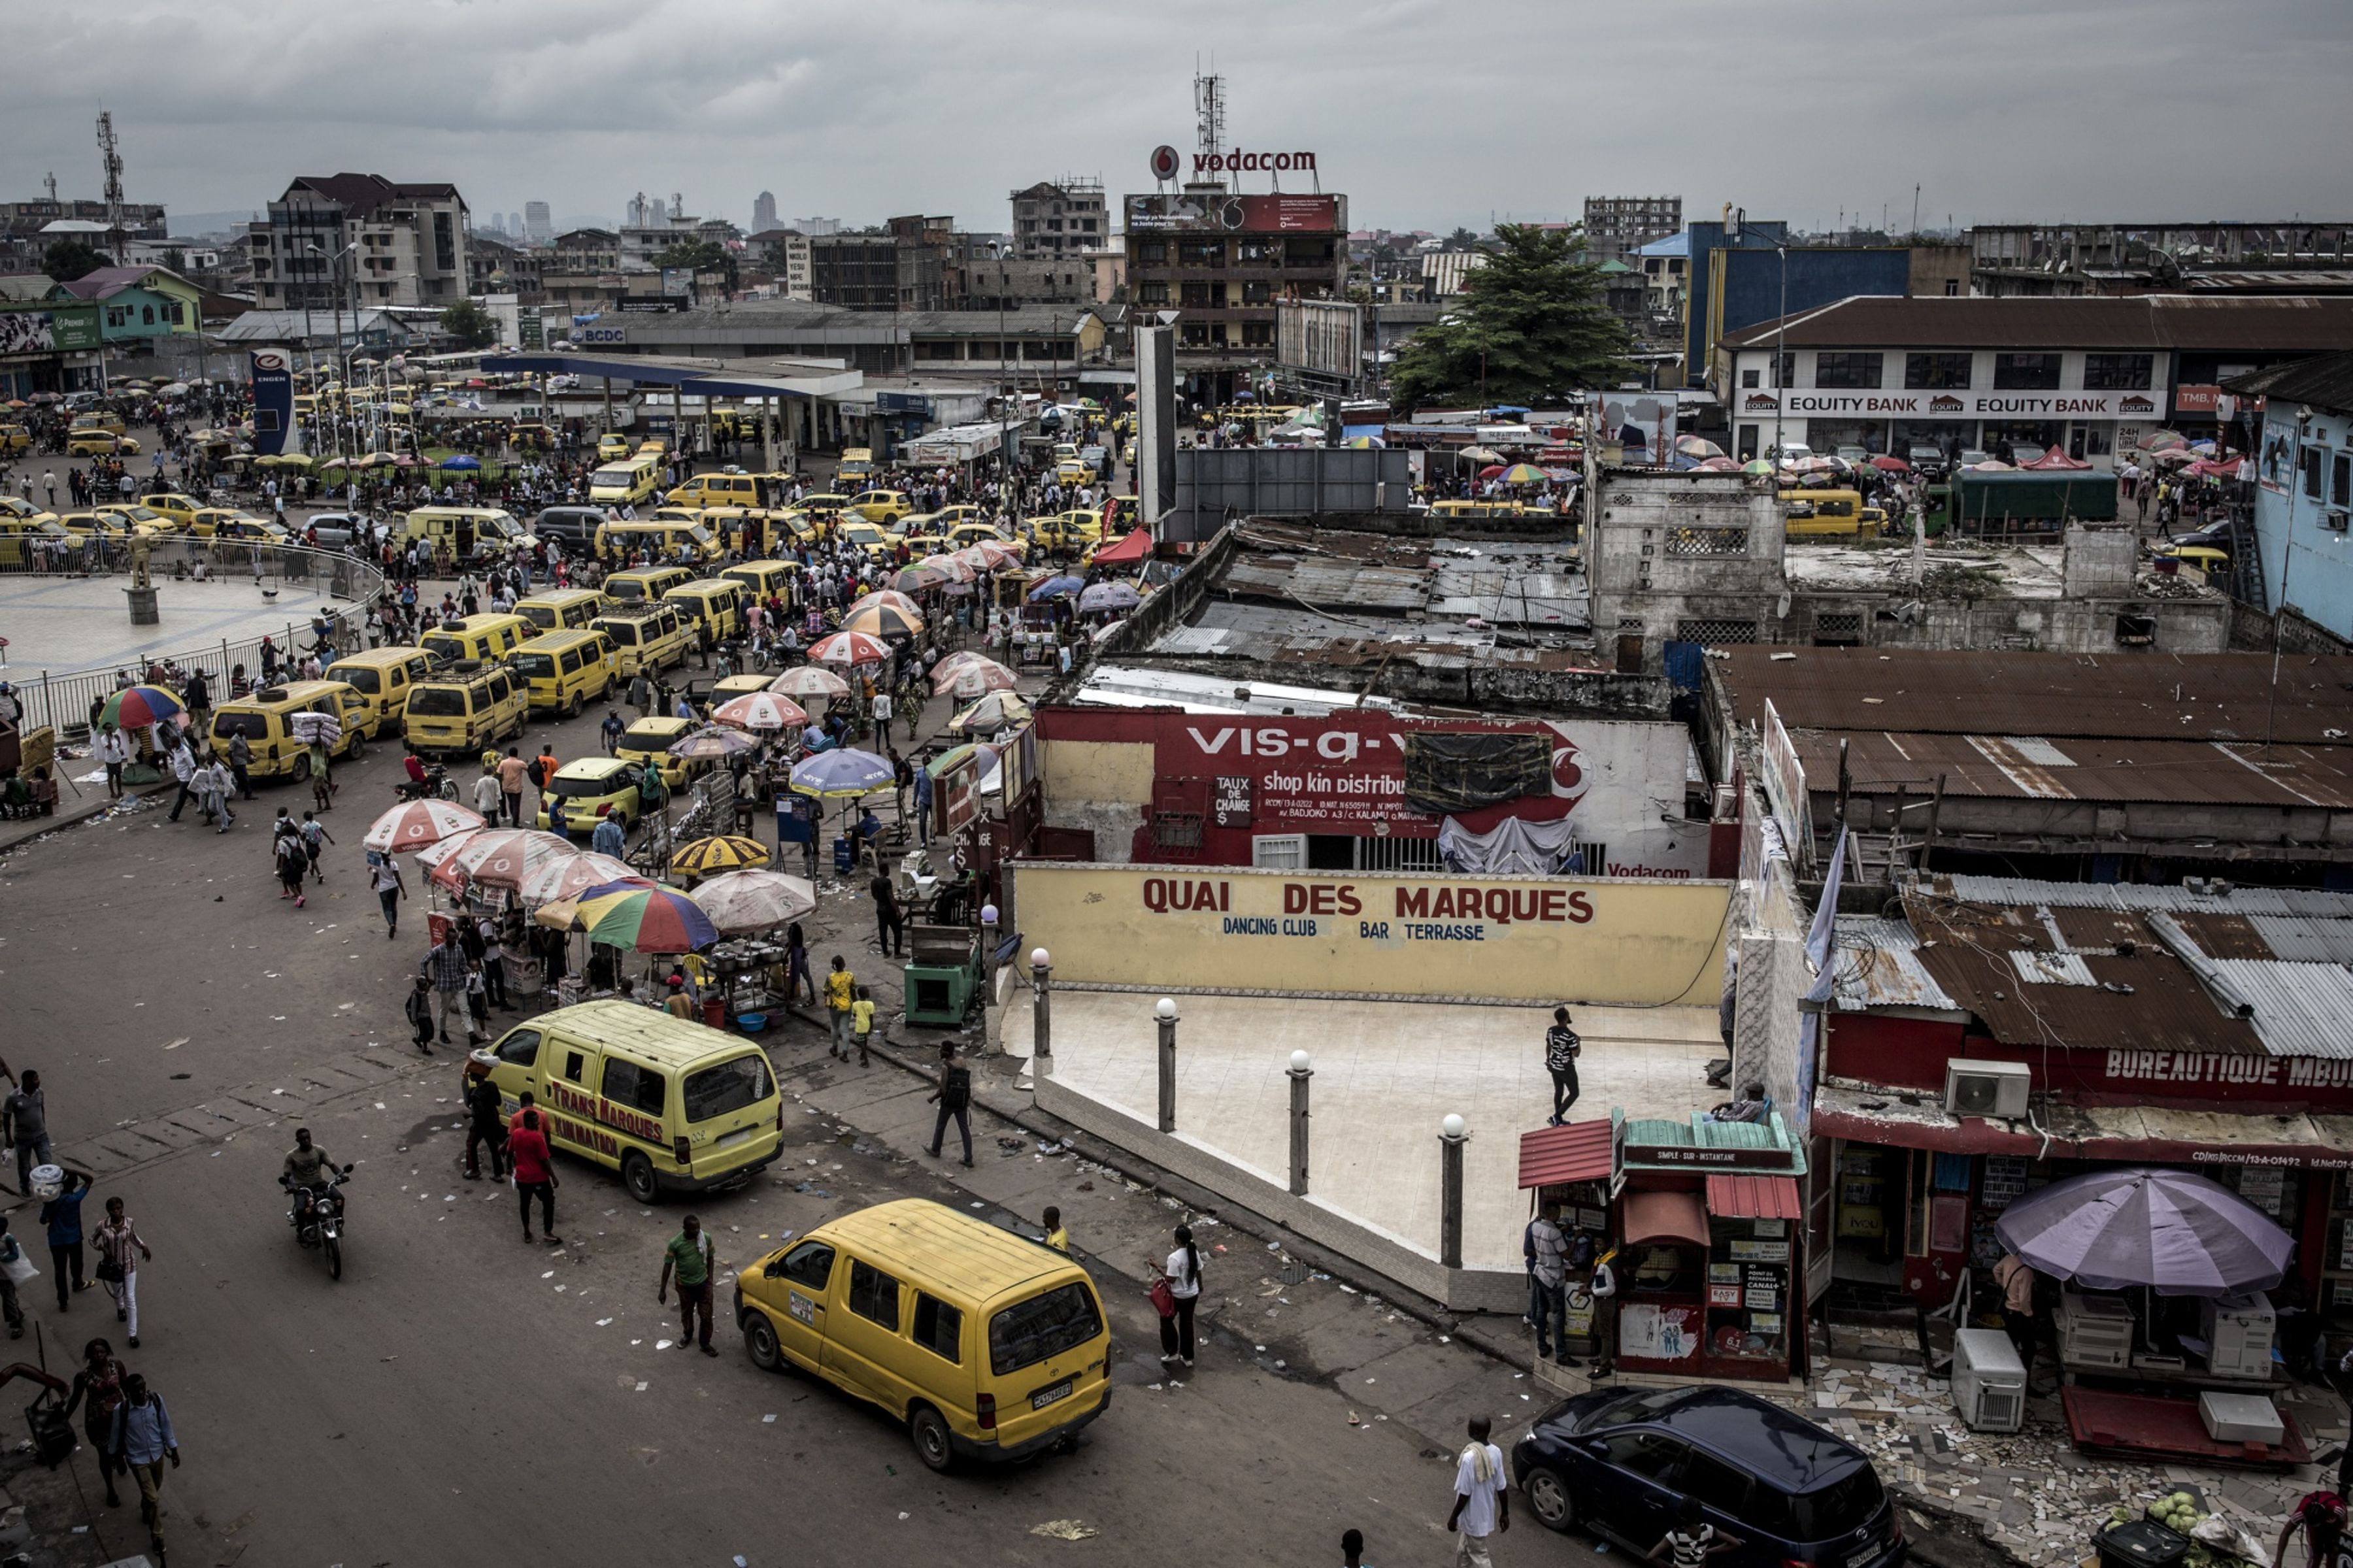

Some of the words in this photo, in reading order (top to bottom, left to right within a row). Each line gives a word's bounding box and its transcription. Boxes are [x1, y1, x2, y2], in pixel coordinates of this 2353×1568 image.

[1193, 148, 1315, 171] vodacom
[585, 330, 624, 341] BCDC
[1790, 397, 1863, 410] EQUITY
[1867, 398, 1918, 411] BANK
[1977, 399, 2052, 412] EQUITY
[2055, 399, 2107, 412] BANK
[542, 761, 548, 772] 3
[1216, 776, 1249, 790] TAUX
[1264, 770, 1302, 795] shop
[1307, 772, 1331, 793] kin
[1227, 790, 1241, 799] DE
[1216, 798, 1250, 812] CHANGE
[1217, 812, 1227, 826] $
[1289, 809, 1327, 818] BADJOKO
[1356, 810, 1389, 820] KALAMU
[954, 833, 992, 846] CHGE
[956, 847, 967, 868] $
[1607, 863, 1690, 878] Vodacom
[482, 878, 513, 886] vodacom
[1143, 878, 1229, 913] QUAI
[1284, 884, 1362, 916] DES
[1395, 887, 1594, 924] MARQUES
[1224, 917, 1277, 935] DANCING
[1283, 919, 1317, 937] CLUB
[1360, 922, 1389, 939] BAR
[1405, 924, 1484, 941] TERRASSE
[2105, 1049, 2280, 1085] BUREAUTIQUE
[552, 1080, 596, 1117] TRANS
[599, 1098, 663, 1143] MARQUES
[1658, 1151, 1678, 1159] SIMPLE
[1699, 1153, 1735, 1162] INSTANTANE
[1726, 1336, 1741, 1347] 6.1
